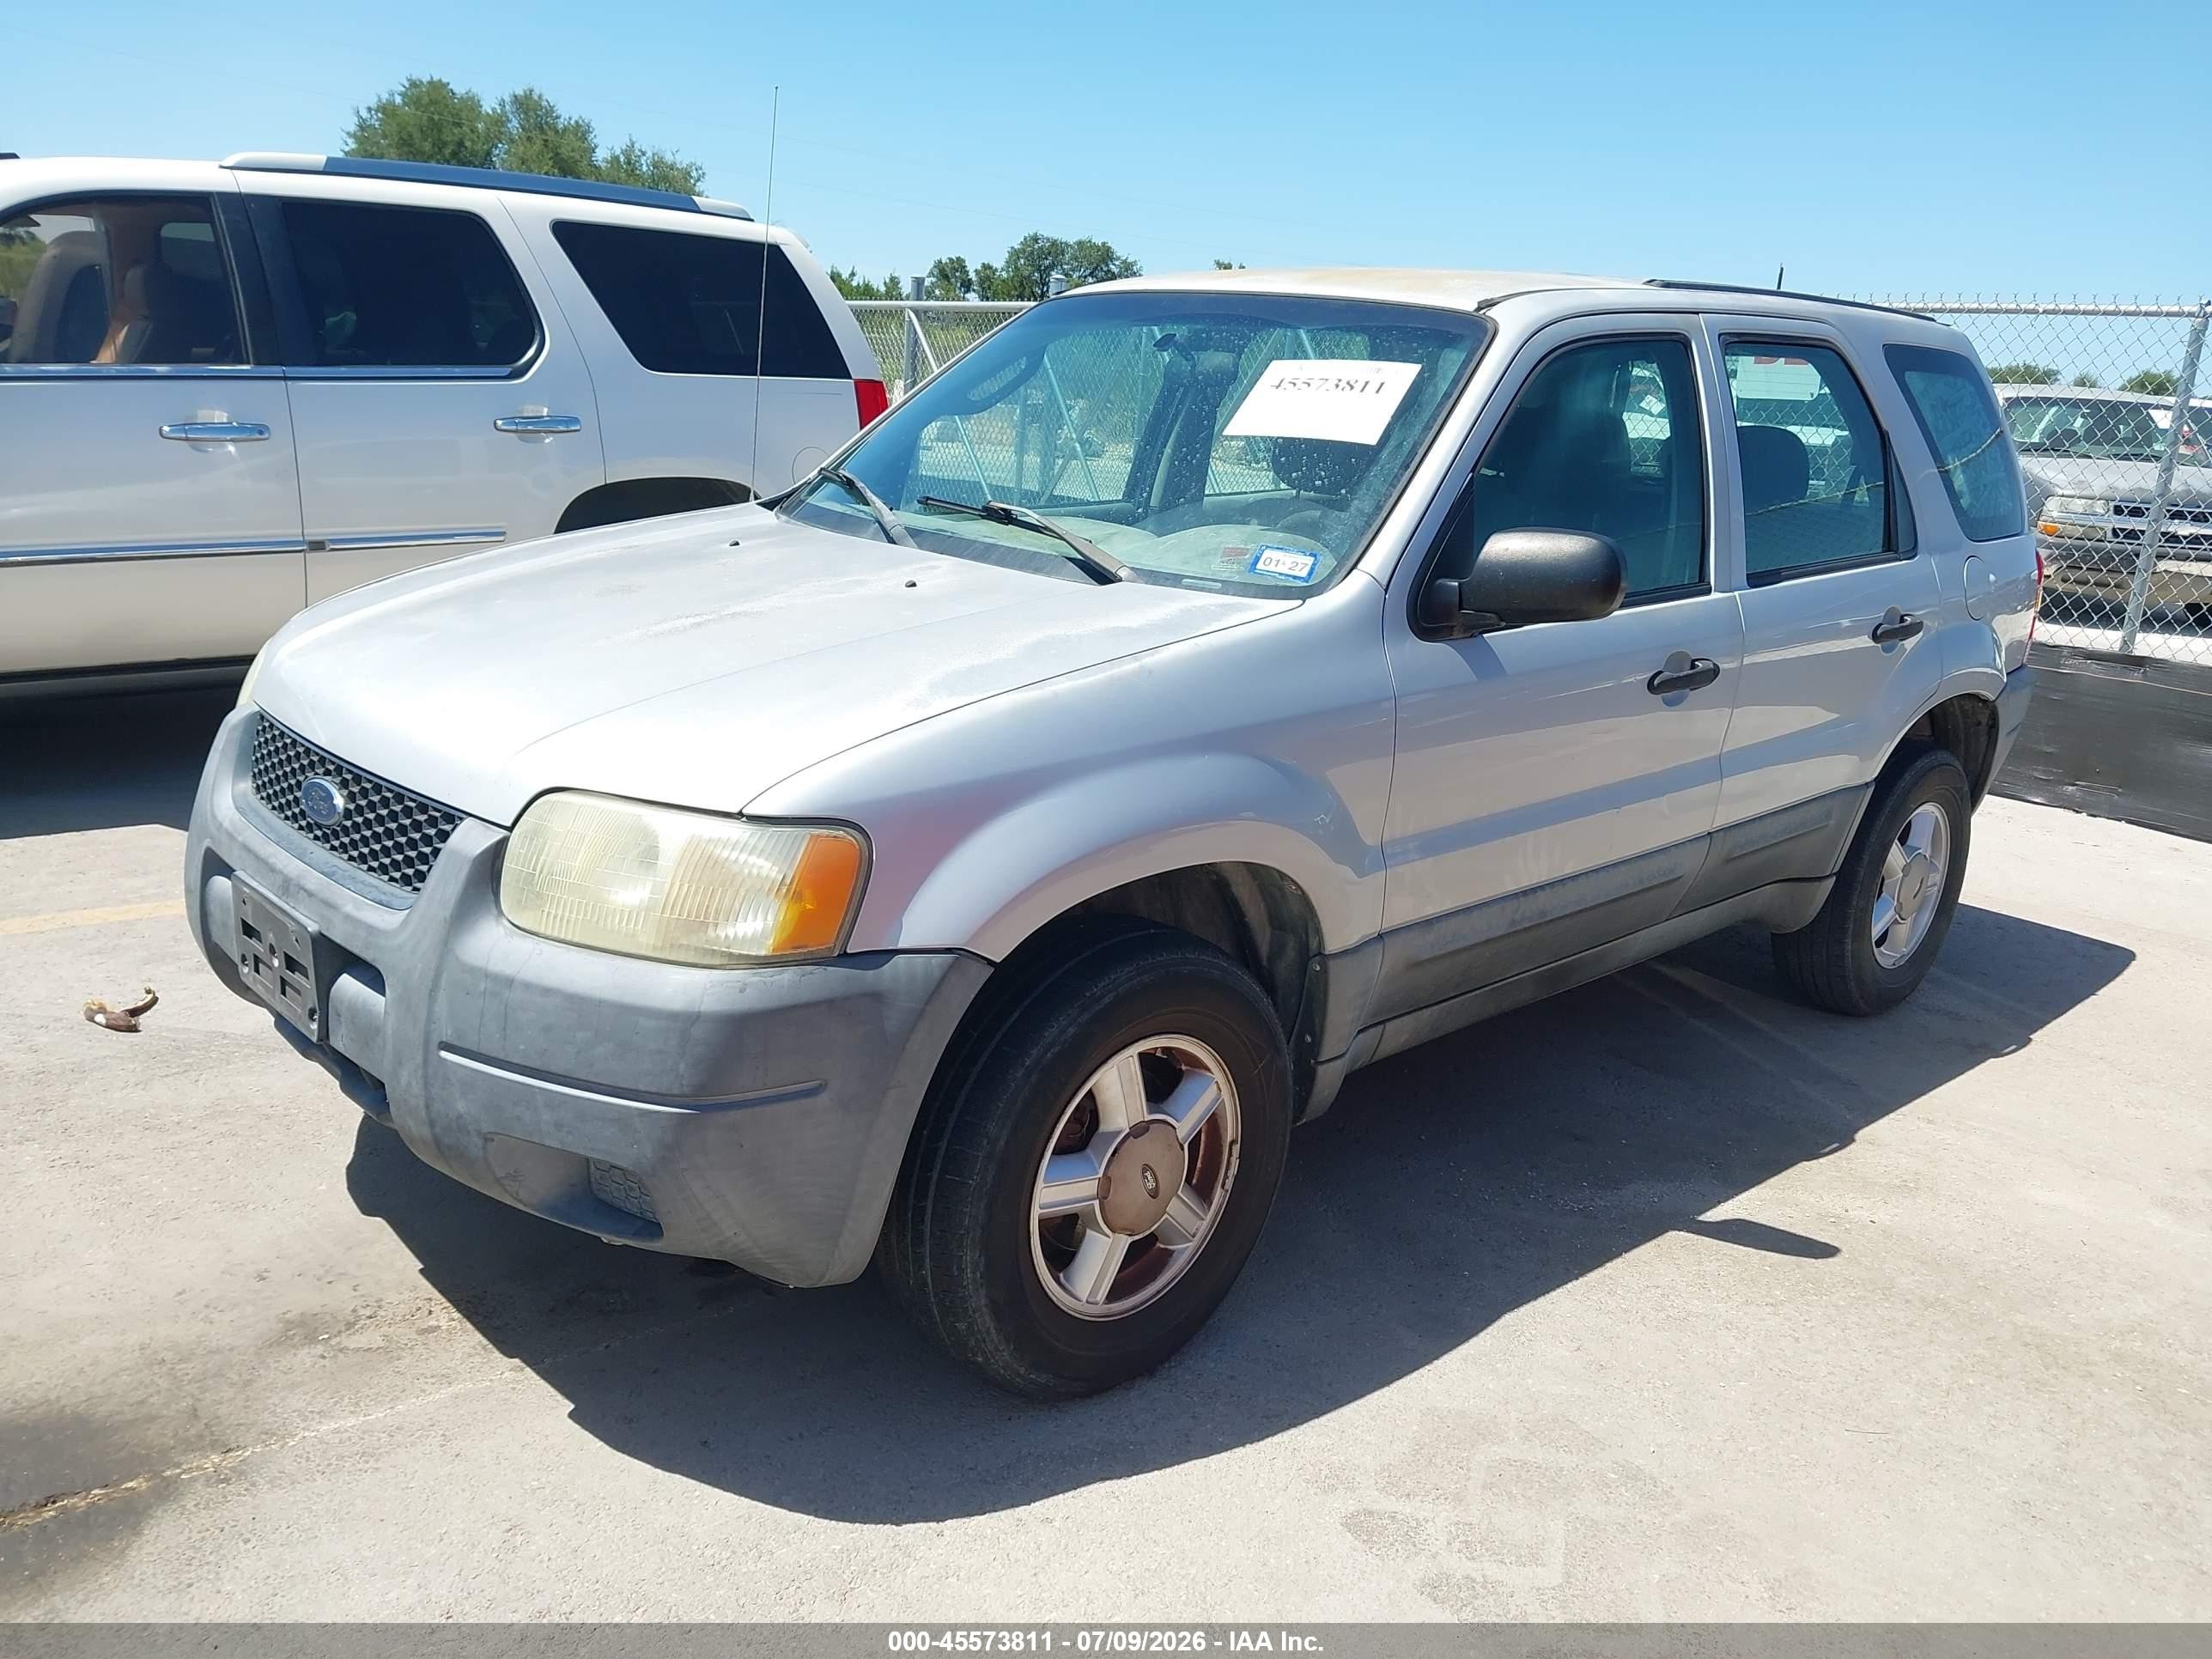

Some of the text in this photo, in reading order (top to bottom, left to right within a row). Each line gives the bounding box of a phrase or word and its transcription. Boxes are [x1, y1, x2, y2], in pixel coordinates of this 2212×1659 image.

[1271, 378, 1386, 394] 45573811
[1262, 556, 1310, 572] 01 27
[1143, 1170, 1156, 1189] Ford
